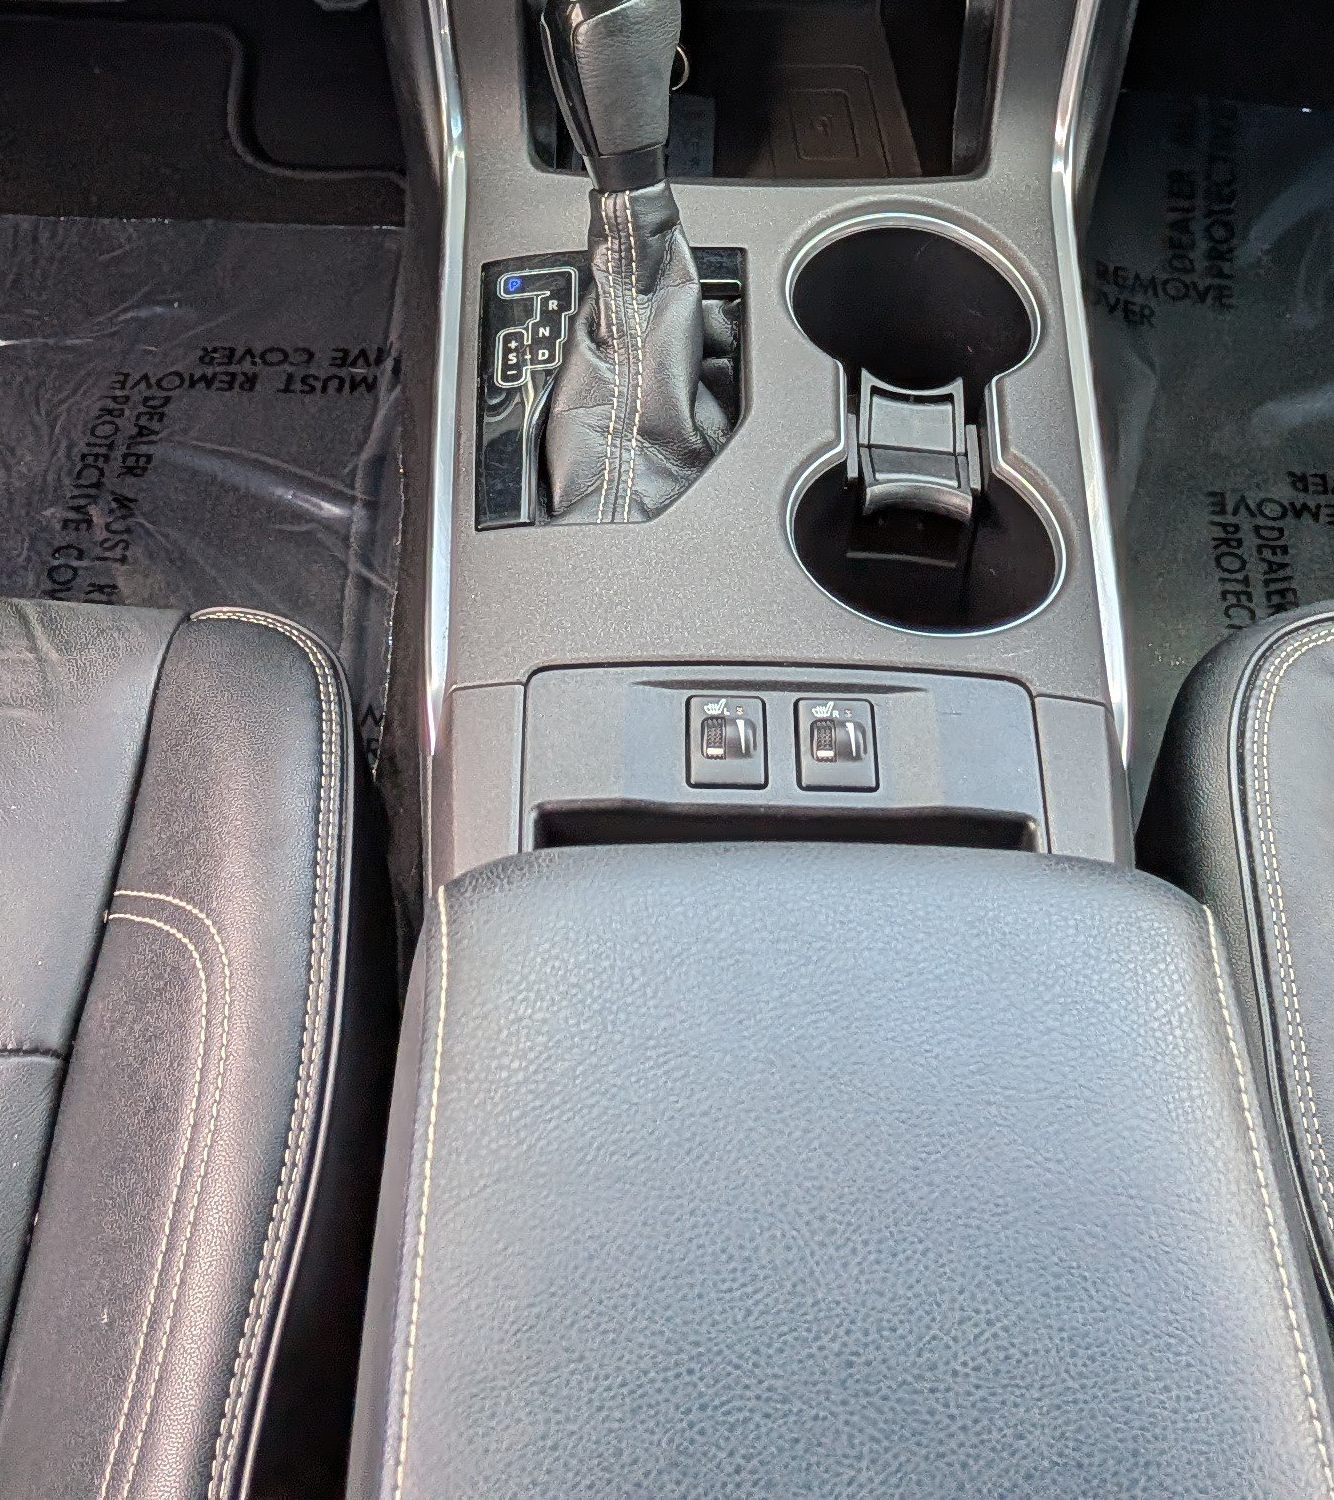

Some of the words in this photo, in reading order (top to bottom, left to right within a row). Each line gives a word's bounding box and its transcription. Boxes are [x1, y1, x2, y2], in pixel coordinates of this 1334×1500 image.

[508, 278, 521, 291] P
[547, 300, 559, 312] R
[538, 326, 550, 338] N
[198, 346, 315, 368] COVER
[507, 352, 518, 366] S
[537, 349, 549, 361] D
[110, 370, 259, 393] REMOVE
[276, 373, 378, 395] MUST
[116, 394, 172, 480] DEALER
[60, 393, 129, 533] PROTECTIVE
